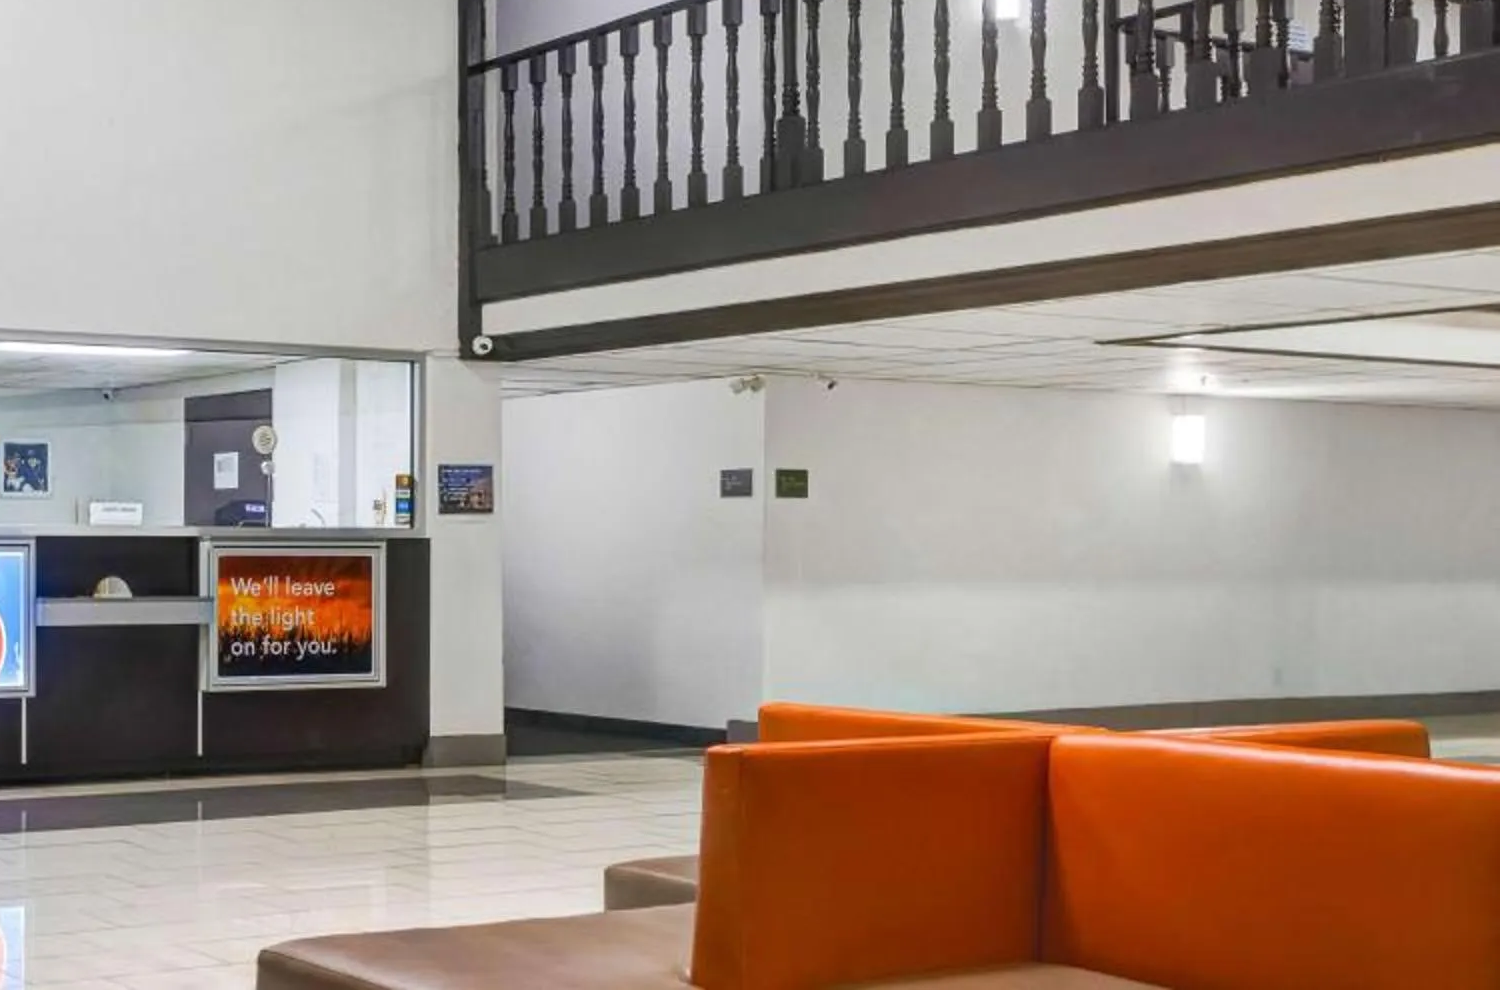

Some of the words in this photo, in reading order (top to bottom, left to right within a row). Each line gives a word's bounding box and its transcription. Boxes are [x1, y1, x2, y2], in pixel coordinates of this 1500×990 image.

[230, 576, 279, 596] We'll
[285, 576, 336, 596] leave
[231, 606, 263, 627] the
[270, 605, 316, 631] light
[230, 640, 256, 657] on
[262, 634, 291, 656] for
[295, 639, 337, 660] you.
